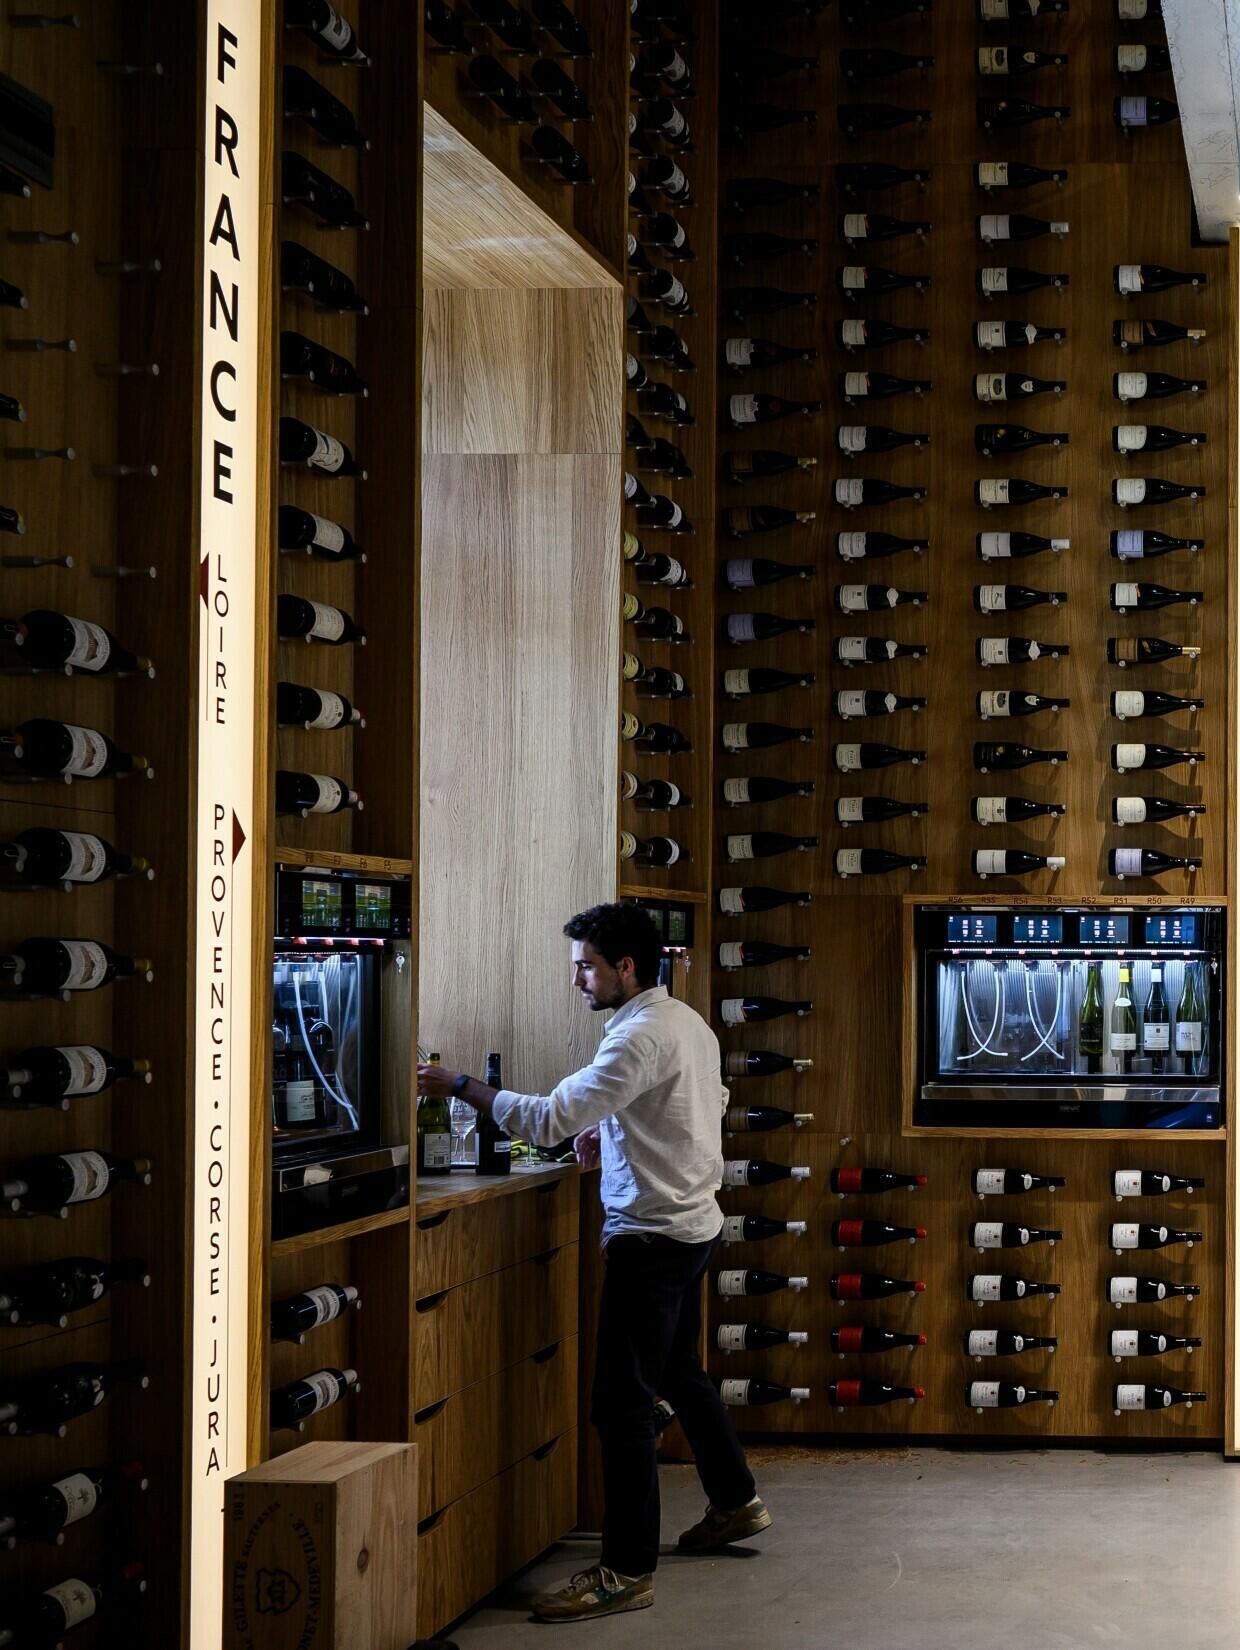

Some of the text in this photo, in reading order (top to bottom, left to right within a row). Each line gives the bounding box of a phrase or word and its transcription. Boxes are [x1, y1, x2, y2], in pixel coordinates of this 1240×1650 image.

[210, 22, 240, 505] FRANCE
[215, 554, 229, 725] LOIRE
[1081, 896, 1096, 905] R52
[1113, 896, 1128, 905] R51
[1147, 896, 1162, 905] R50
[1180, 896, 1195, 905] R49
[206, 803, 226, 1478] PROVENCE CORSE JURA
